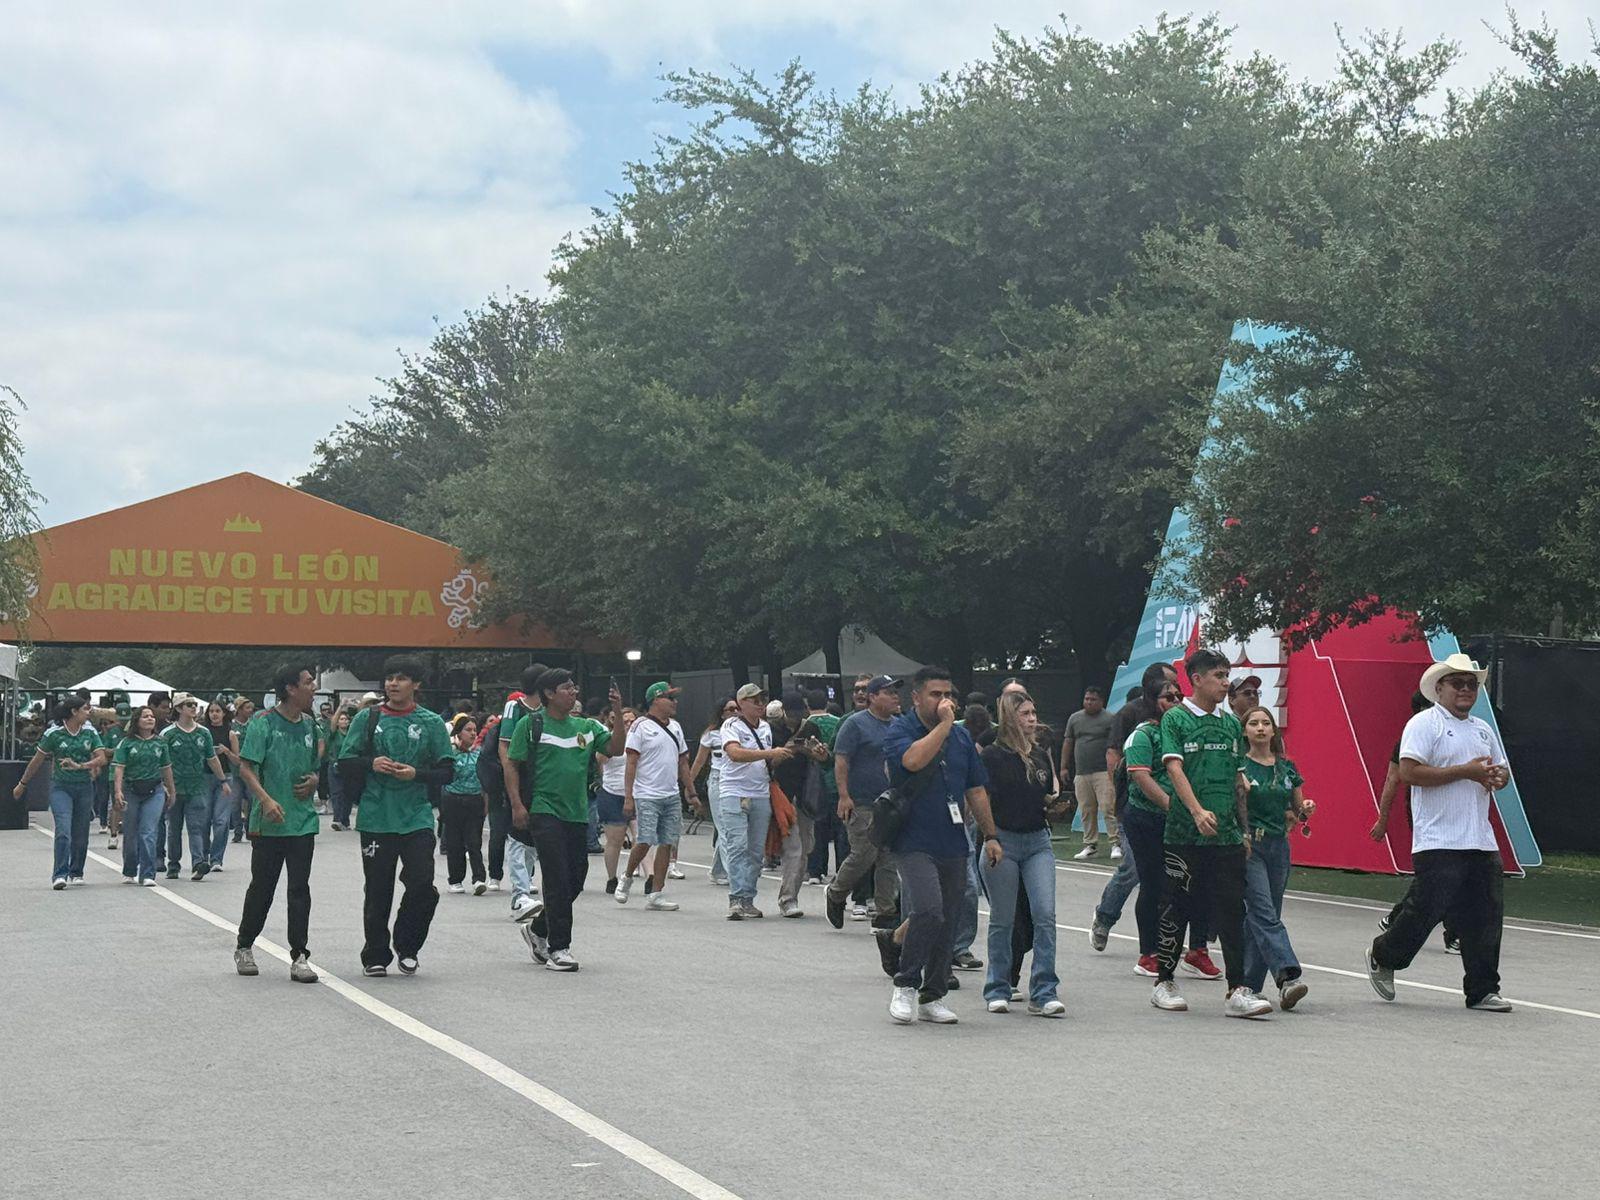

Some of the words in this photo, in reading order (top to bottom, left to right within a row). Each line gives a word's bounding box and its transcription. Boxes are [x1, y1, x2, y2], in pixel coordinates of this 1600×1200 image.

[109, 549, 257, 580] NUEVO
[272, 549, 379, 582] LEÓN
[48, 582, 253, 614] AGRADECE
[261, 587, 309, 615] TU
[315, 588, 436, 616] VISITA
[1155, 607, 1163, 648] FIFA
